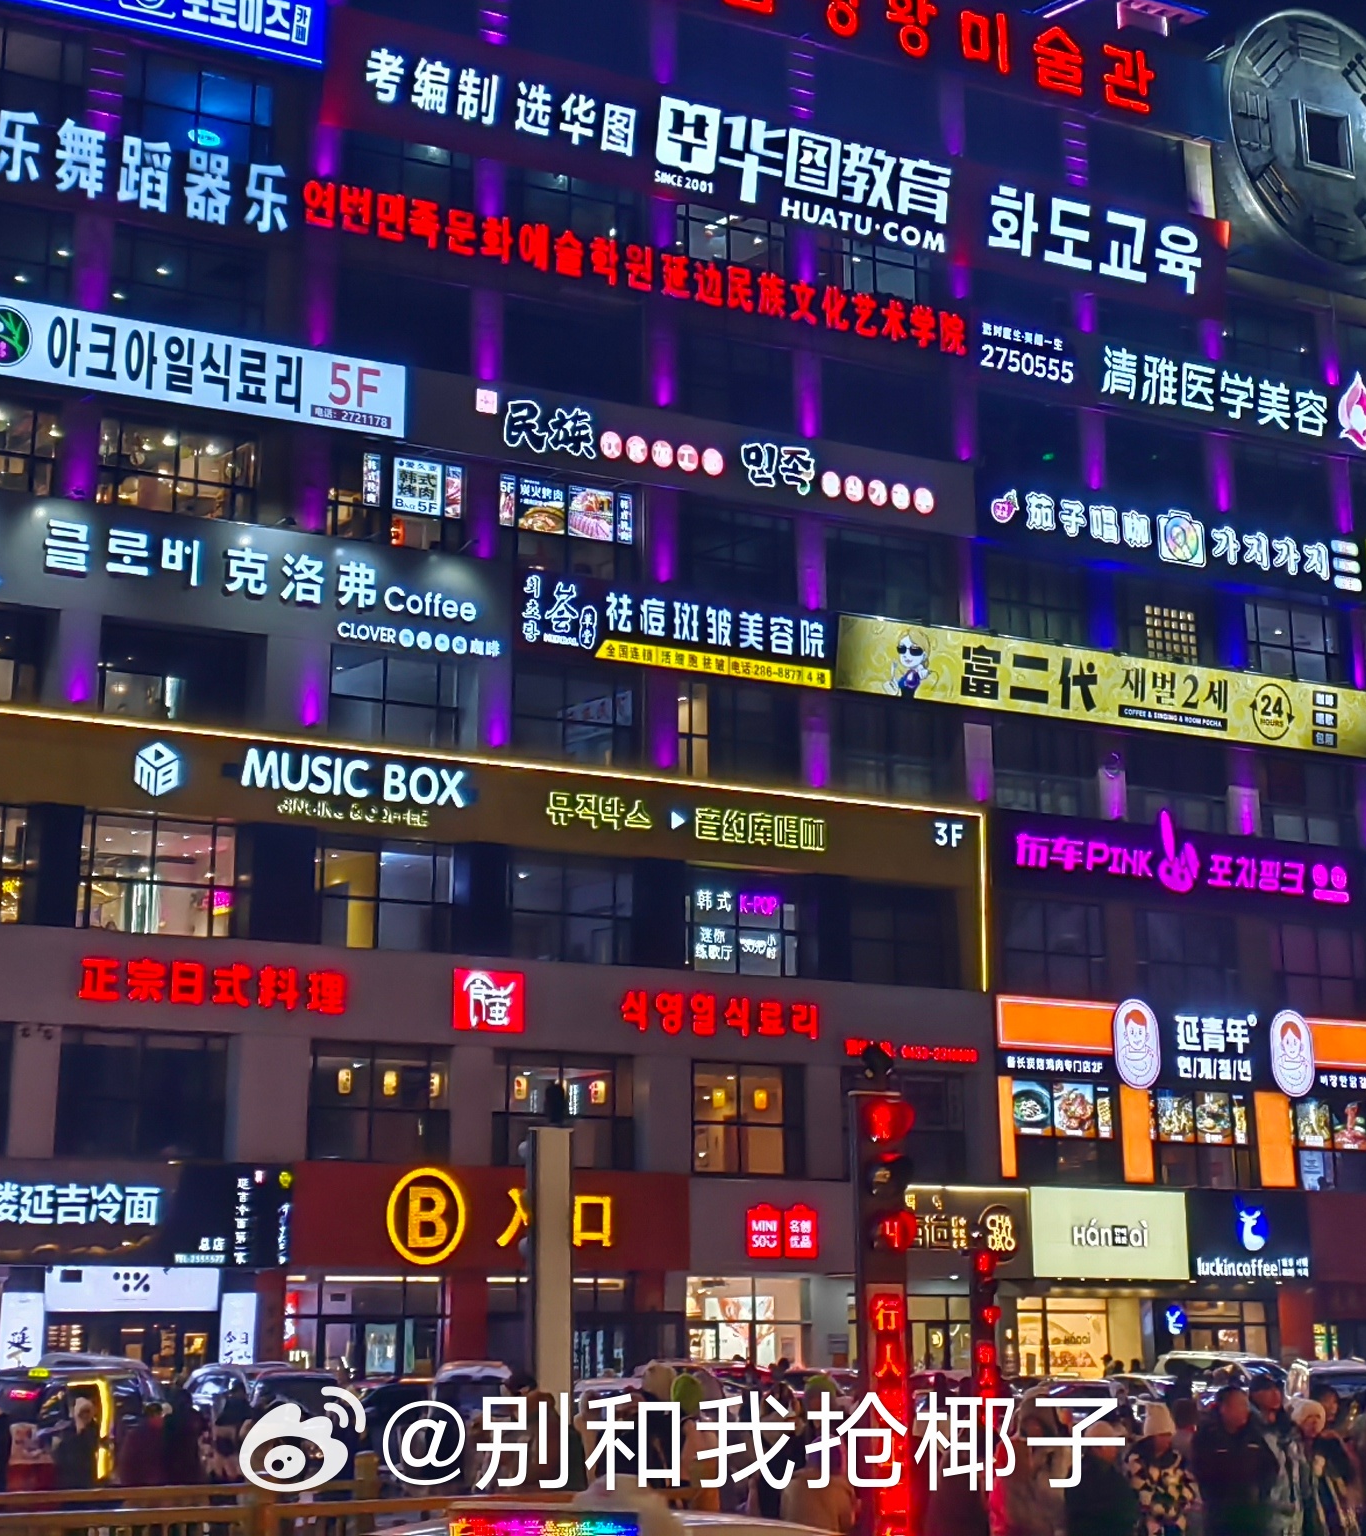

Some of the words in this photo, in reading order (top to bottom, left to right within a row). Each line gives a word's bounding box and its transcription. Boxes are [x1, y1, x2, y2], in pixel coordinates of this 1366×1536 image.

[366, 48, 498, 126] 考编制
[514, 80, 638, 158] 选华图
[654, 169, 683, 188] SINCE
[685, 175, 714, 194] 2001
[718, 114, 953, 225] 华图教育
[302, 177, 657, 292] 연변민족문화예술학원
[988, 182, 1204, 296] 화도교육
[660, 254, 967, 357] 延边民族文化艺术学院
[46, 316, 304, 414] 아크아일식료리
[327, 362, 383, 408] 5F
[980, 344, 1074, 384] 2750555
[1101, 344, 1329, 438] 清雅医学美容
[417, 501, 438, 513] 5F
[1210, 525, 1331, 582] 가지가지
[225, 545, 378, 609] 克洛弗
[383, 585, 477, 622] Coffee
[337, 622, 396, 644] CLOVER
[961, 643, 1098, 712] 富二代
[1120, 666, 1229, 714] 재벌2세
[1260, 694, 1284, 718] 24
[1260, 717, 1284, 729] HOURS
[240, 747, 370, 798] MUSIC
[383, 763, 467, 809] BOX
[546, 791, 653, 831] 뮤직박스
[934, 822, 964, 847] 3F
[1208, 852, 1305, 896] 포차핑크
[697, 889, 732, 912] 韩式
[78, 956, 348, 1016] 正宗日式料理
[1175, 1015, 1251, 1054] 延青年
[751, 1219, 778, 1233] MINI
